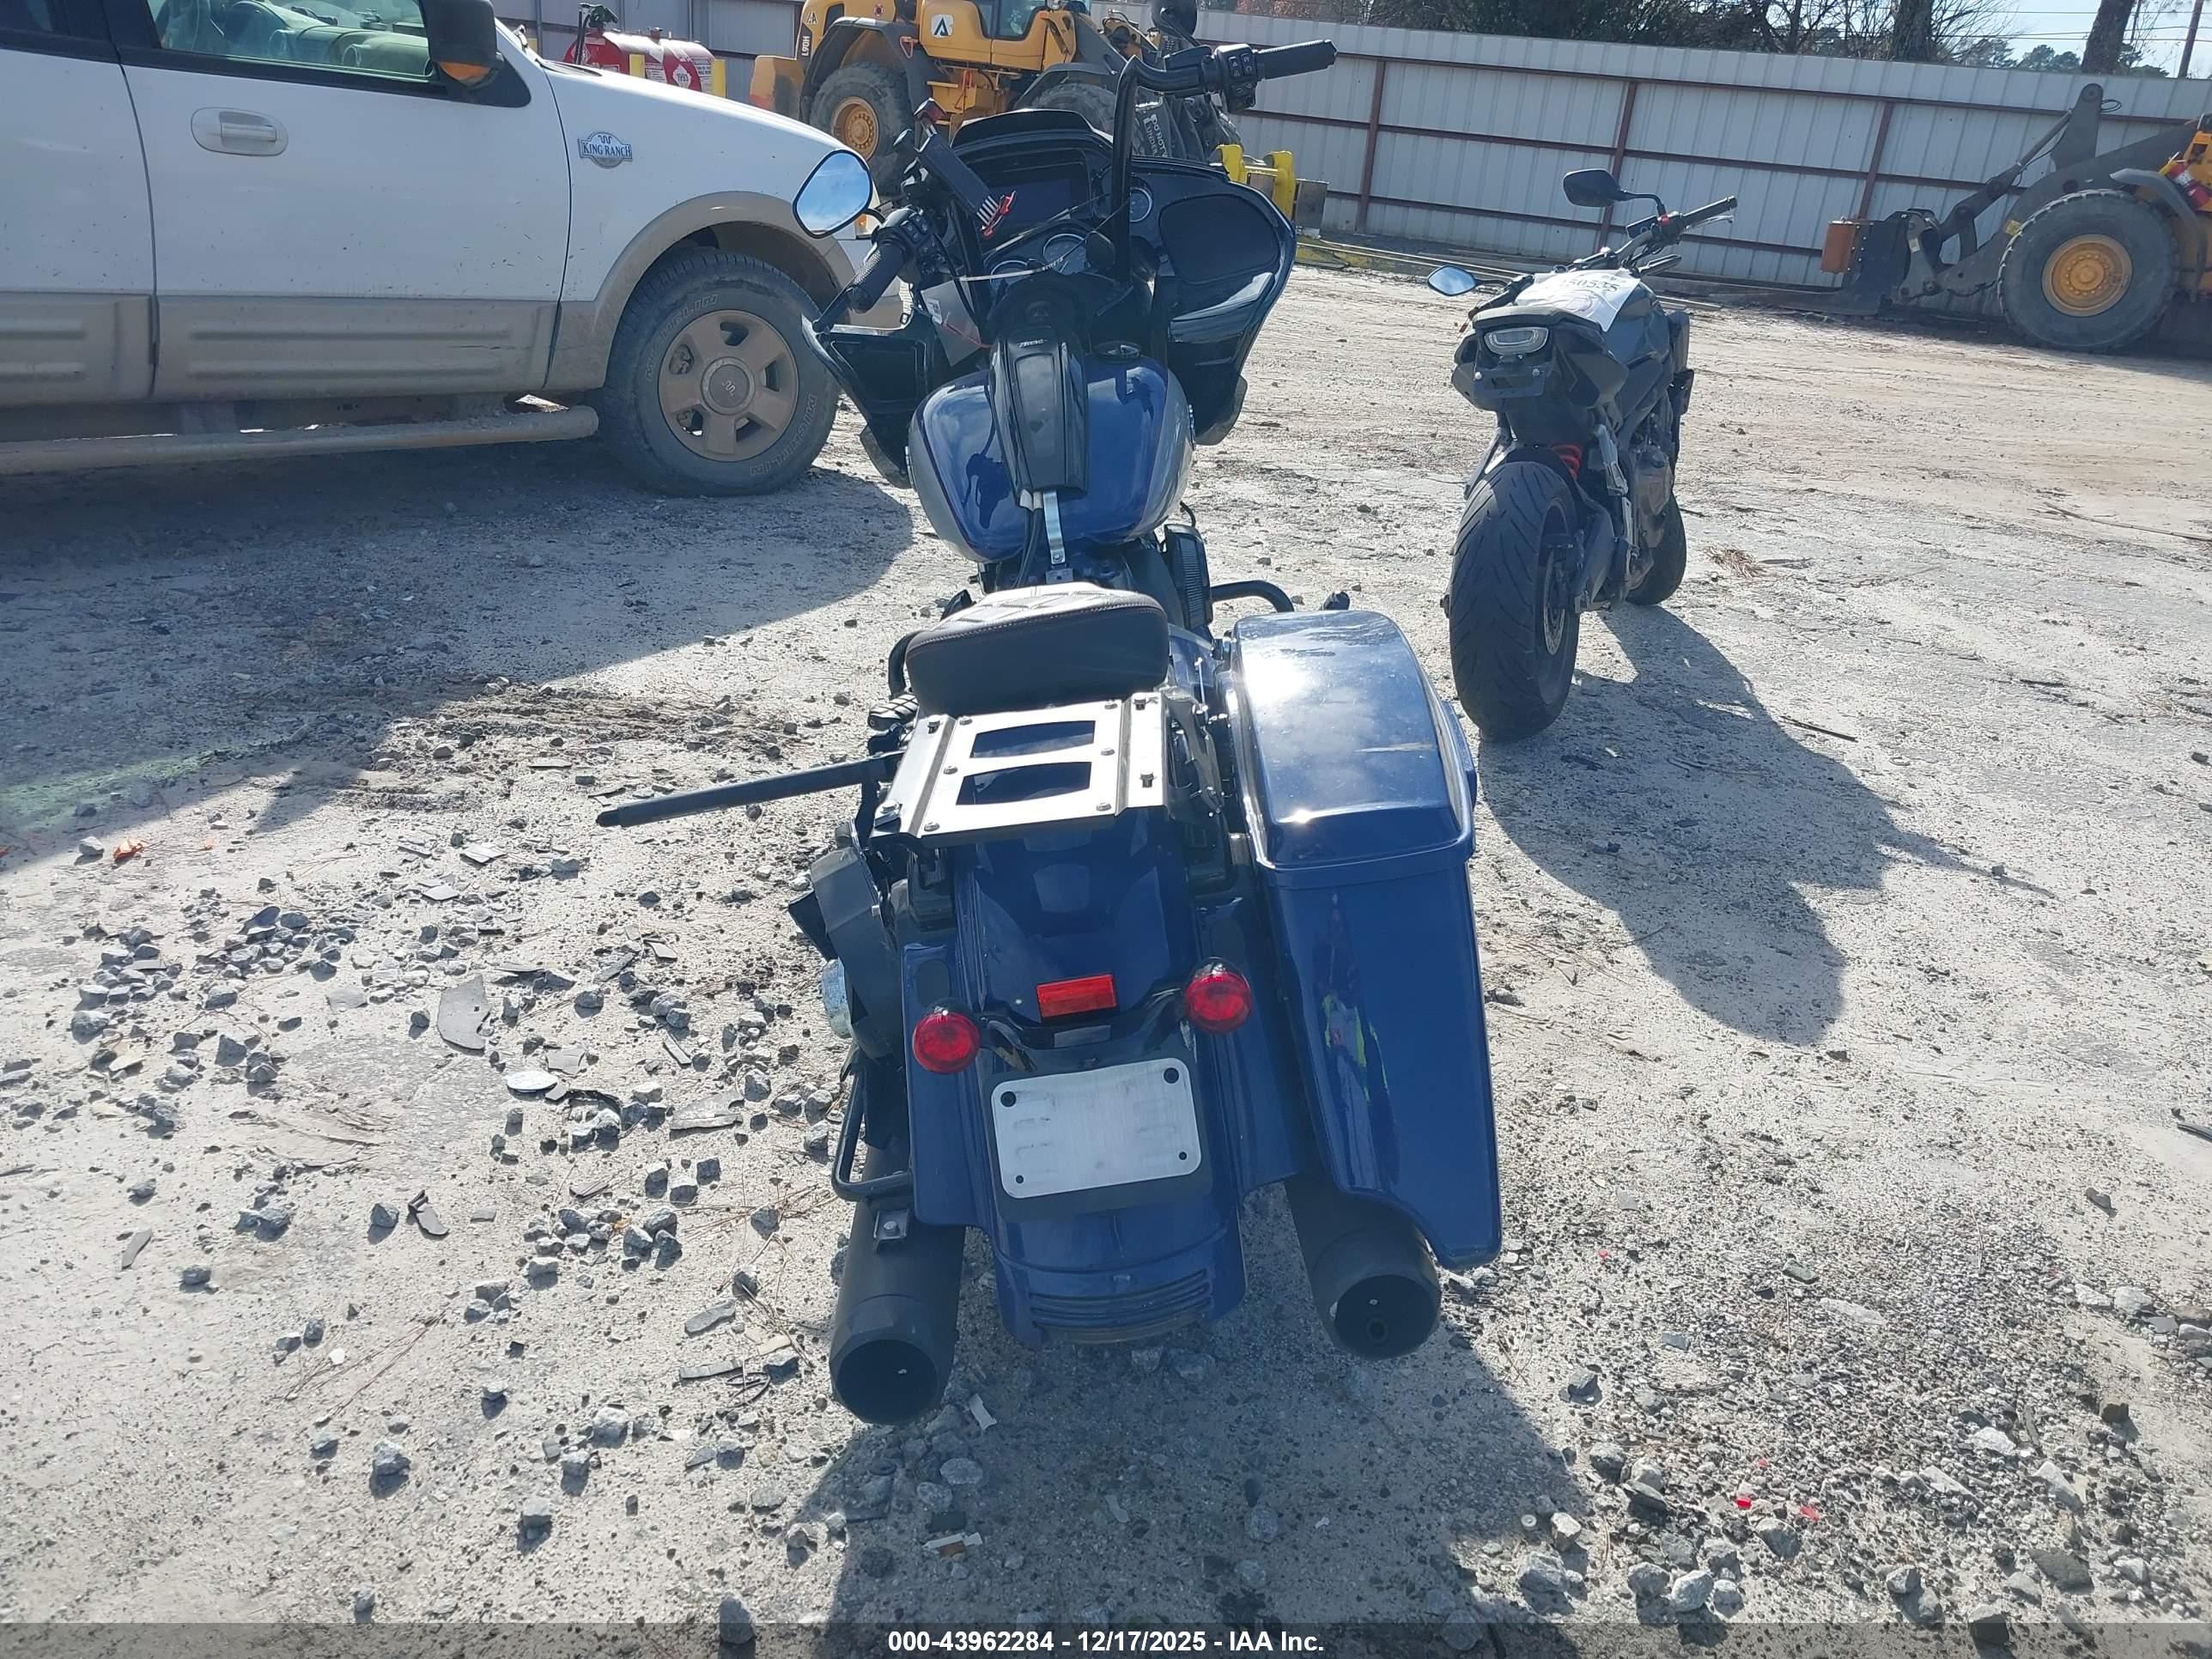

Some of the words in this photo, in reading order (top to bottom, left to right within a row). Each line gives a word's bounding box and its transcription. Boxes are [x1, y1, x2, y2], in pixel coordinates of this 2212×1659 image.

[801, 35, 811, 57] L90H
[582, 142, 603, 155] KING
[604, 144, 631, 157] RANCH
